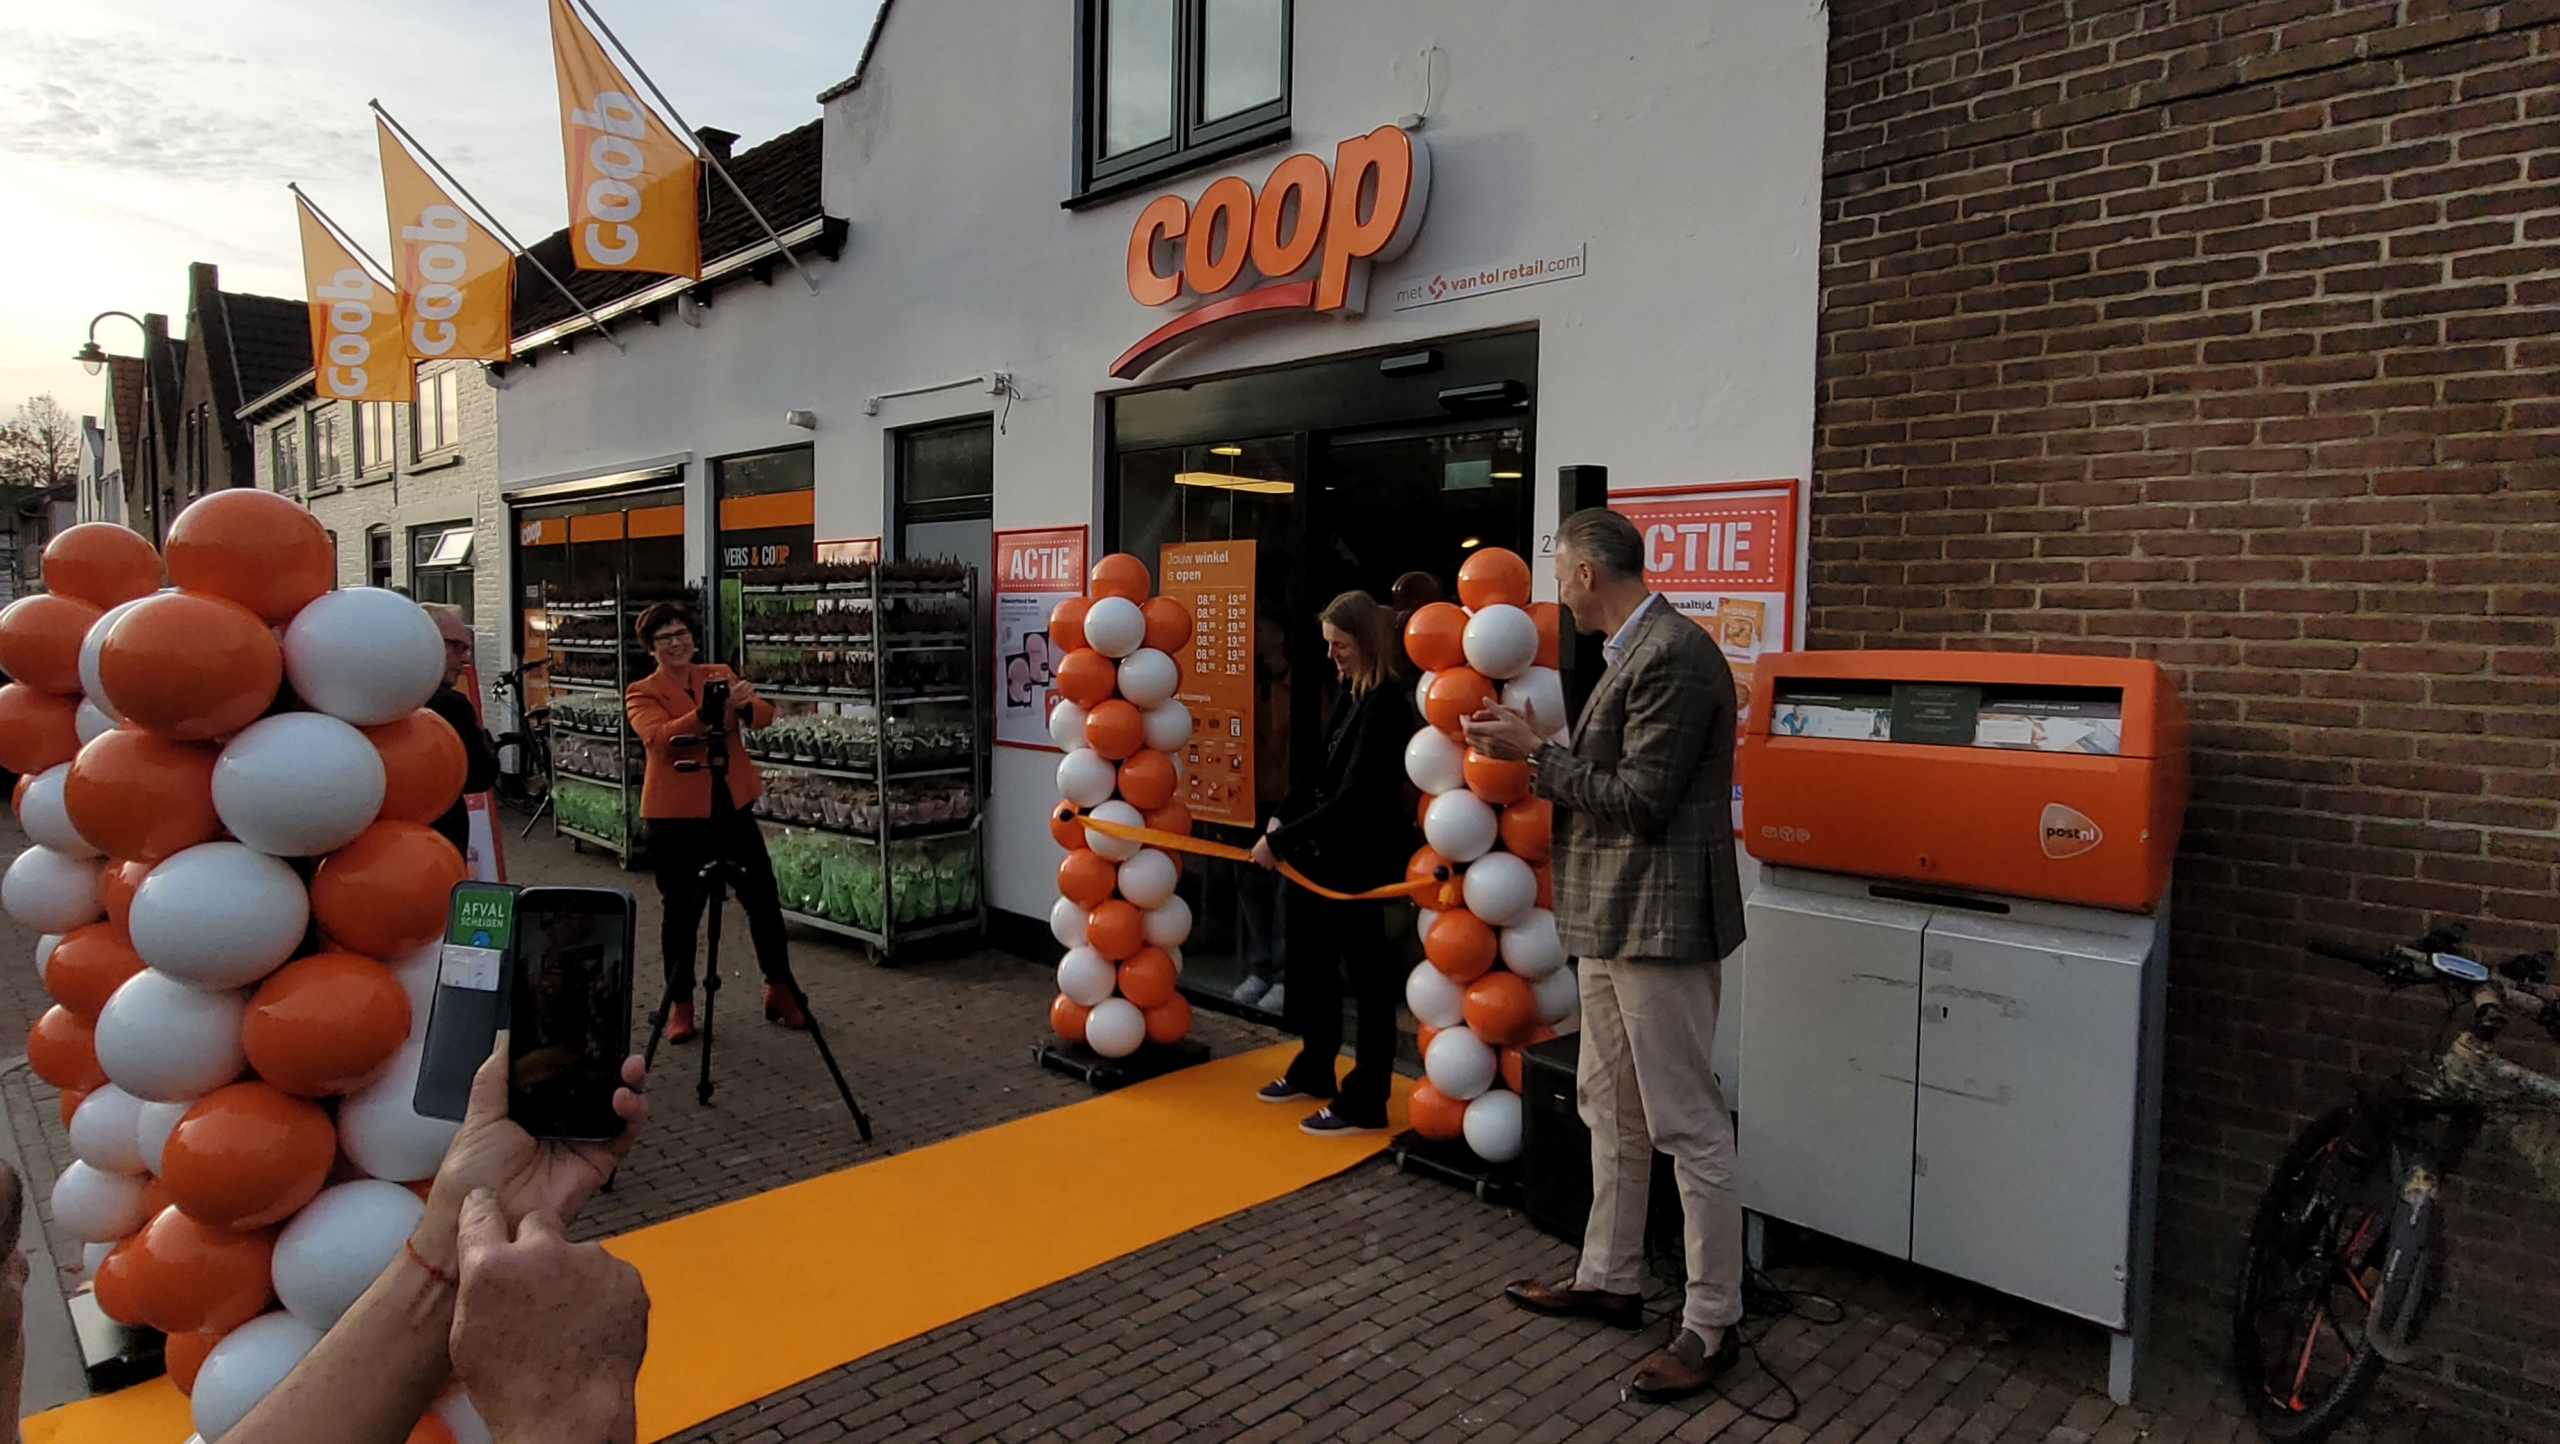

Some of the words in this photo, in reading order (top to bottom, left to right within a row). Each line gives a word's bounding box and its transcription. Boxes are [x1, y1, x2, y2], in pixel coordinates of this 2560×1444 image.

[1126, 124, 1412, 312] coop
[1397, 286, 1422, 301] met
[1451, 277, 1476, 291] van
[1480, 269, 1499, 285] tol
[1502, 256, 1580, 282] retail.com
[724, 547, 748, 566] VERS
[751, 546, 759, 566] &
[762, 545, 789, 566] COOP
[1167, 553, 1192, 564] Jouw
[1195, 550, 1229, 563] winkel
[1644, 522, 1752, 572] CTIE
[1010, 547, 1069, 580] ACTIE
[1167, 571, 1174, 580] is
[1176, 571, 1201, 583] open
[2047, 828, 2095, 840] postnl
[462, 902, 505, 917] AFVAL
